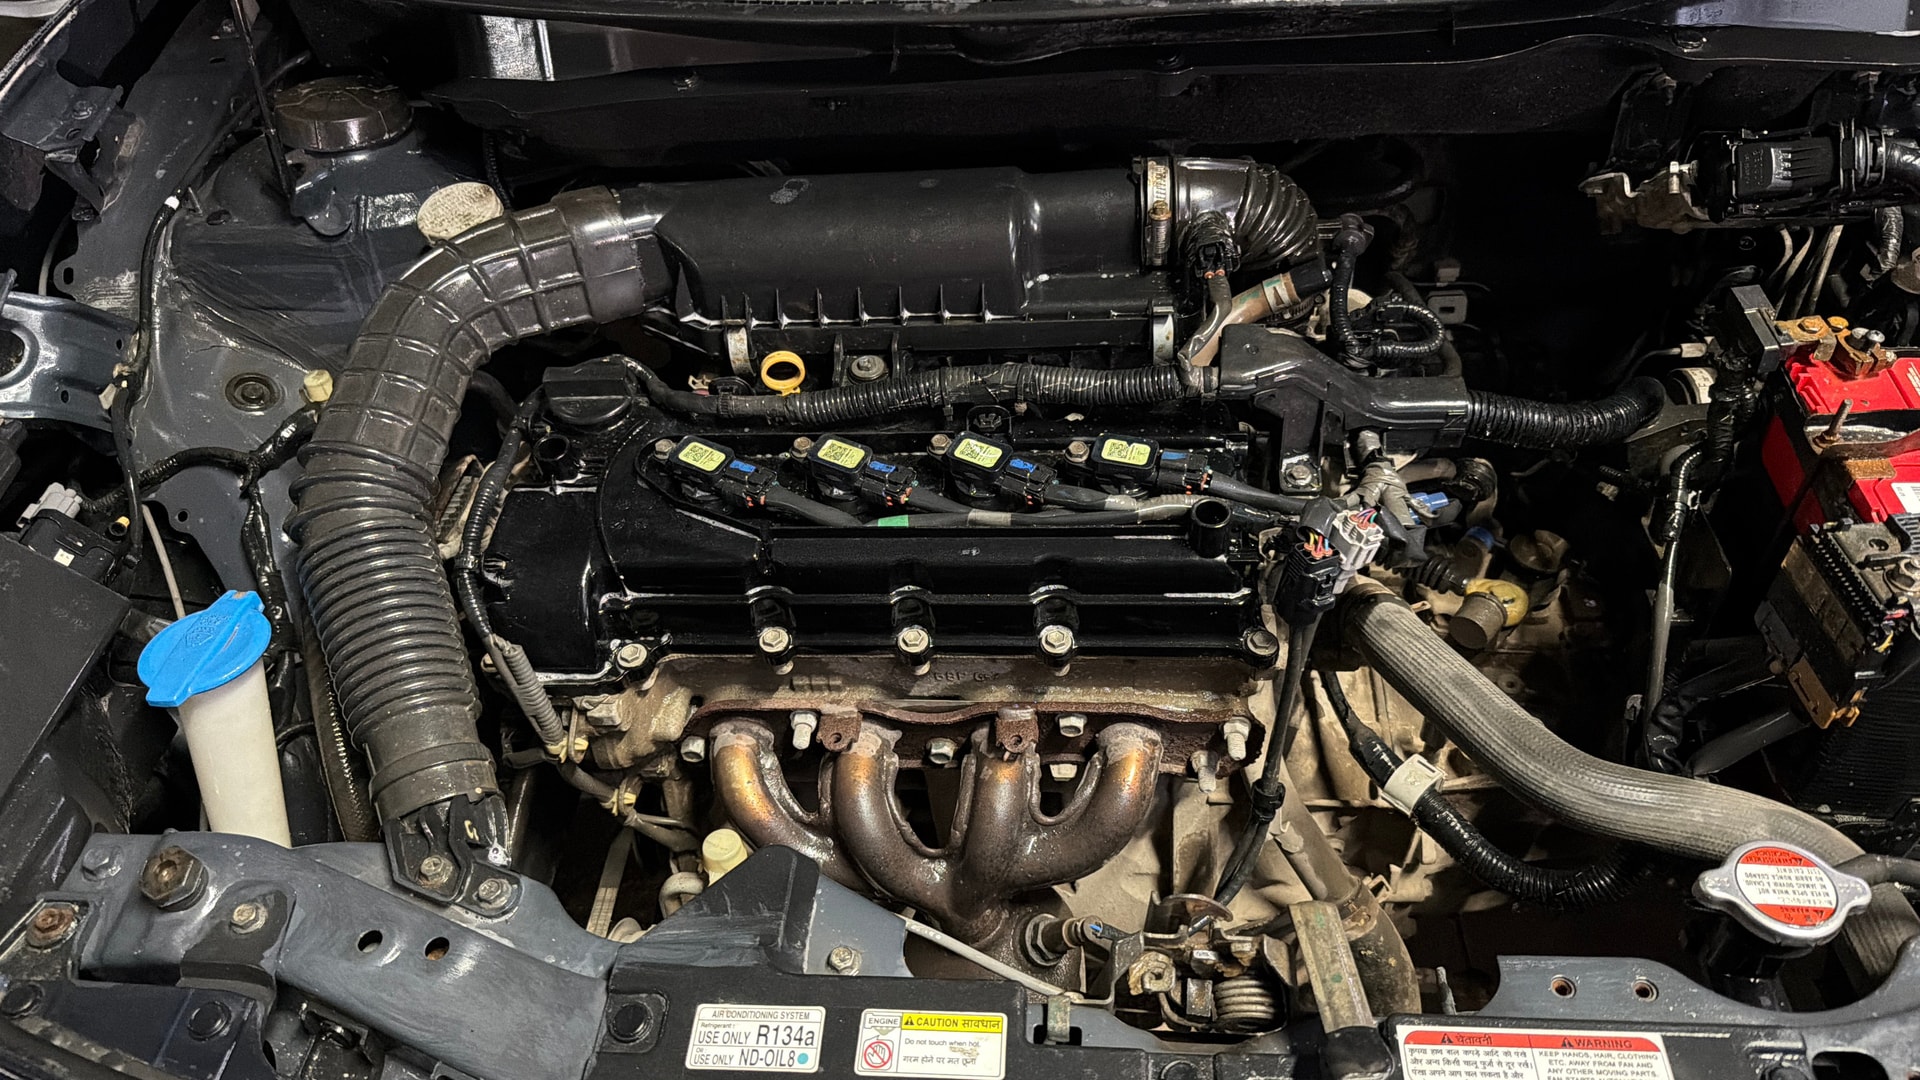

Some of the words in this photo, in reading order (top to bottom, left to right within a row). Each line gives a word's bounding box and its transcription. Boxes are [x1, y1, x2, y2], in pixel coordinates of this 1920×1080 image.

[712, 1010, 725, 1018] AIR
[726, 1010, 778, 1019] CONDITIONING
[780, 1011, 810, 1020] SYSTEM
[868, 1017, 899, 1025] ENGINE
[916, 1017, 958, 1028] CAUTION
[962, 1018, 1001, 1029] सावधान
[698, 1030, 720, 1044] USE
[722, 1030, 751, 1045] ONLY
[756, 1024, 815, 1046] R134a
[904, 1037, 915, 1045] Do
[1574, 1038, 1633, 1049] WARNING
[694, 1053, 711, 1065] USE
[712, 1054, 735, 1065] ONLY
[738, 1048, 796, 1067] ND-OIL8
